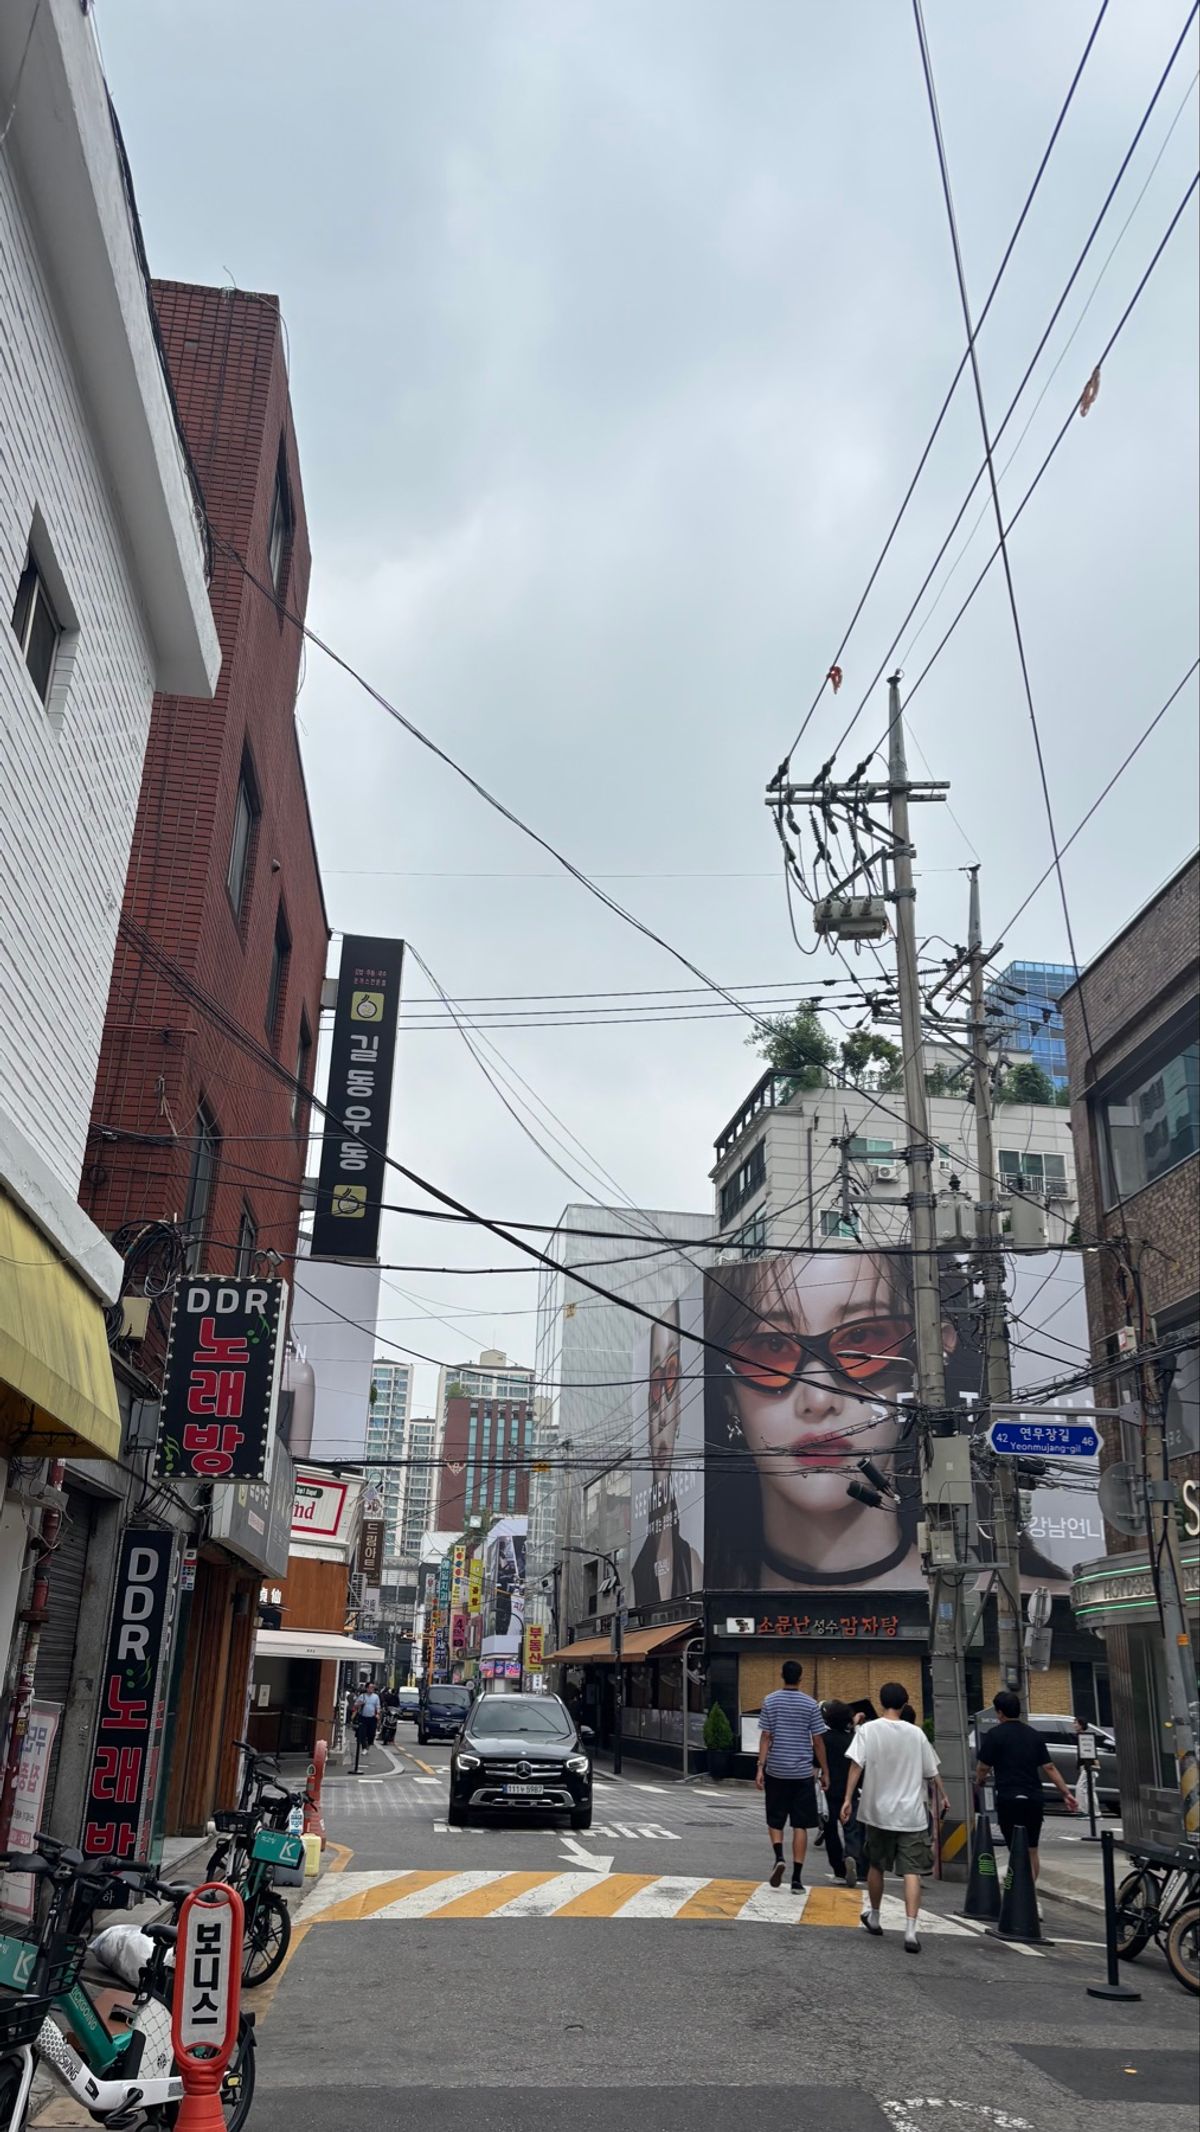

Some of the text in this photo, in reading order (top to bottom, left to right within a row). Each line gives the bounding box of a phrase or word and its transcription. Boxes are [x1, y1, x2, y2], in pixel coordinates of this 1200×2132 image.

[339, 1033, 379, 1172] 길동우동
[186, 1287, 269, 1315] DDR
[182, 1316, 251, 1476] 노래방
[996, 1433, 1009, 1443] 42
[1019, 1426, 1070, 1443] 연무장길
[1082, 1436, 1094, 1447] 46
[1010, 1441, 1082, 1455] Yeonmujang-gil
[293, 1500, 316, 1520] nd
[1028, 1516, 1105, 1541] 강남언니
[117, 1546, 160, 1663] DDR
[757, 1615, 899, 1637] 소문난 성수 감자탕
[528, 1627, 543, 1665] 부동산
[190, 1922, 222, 2025] 보니스
